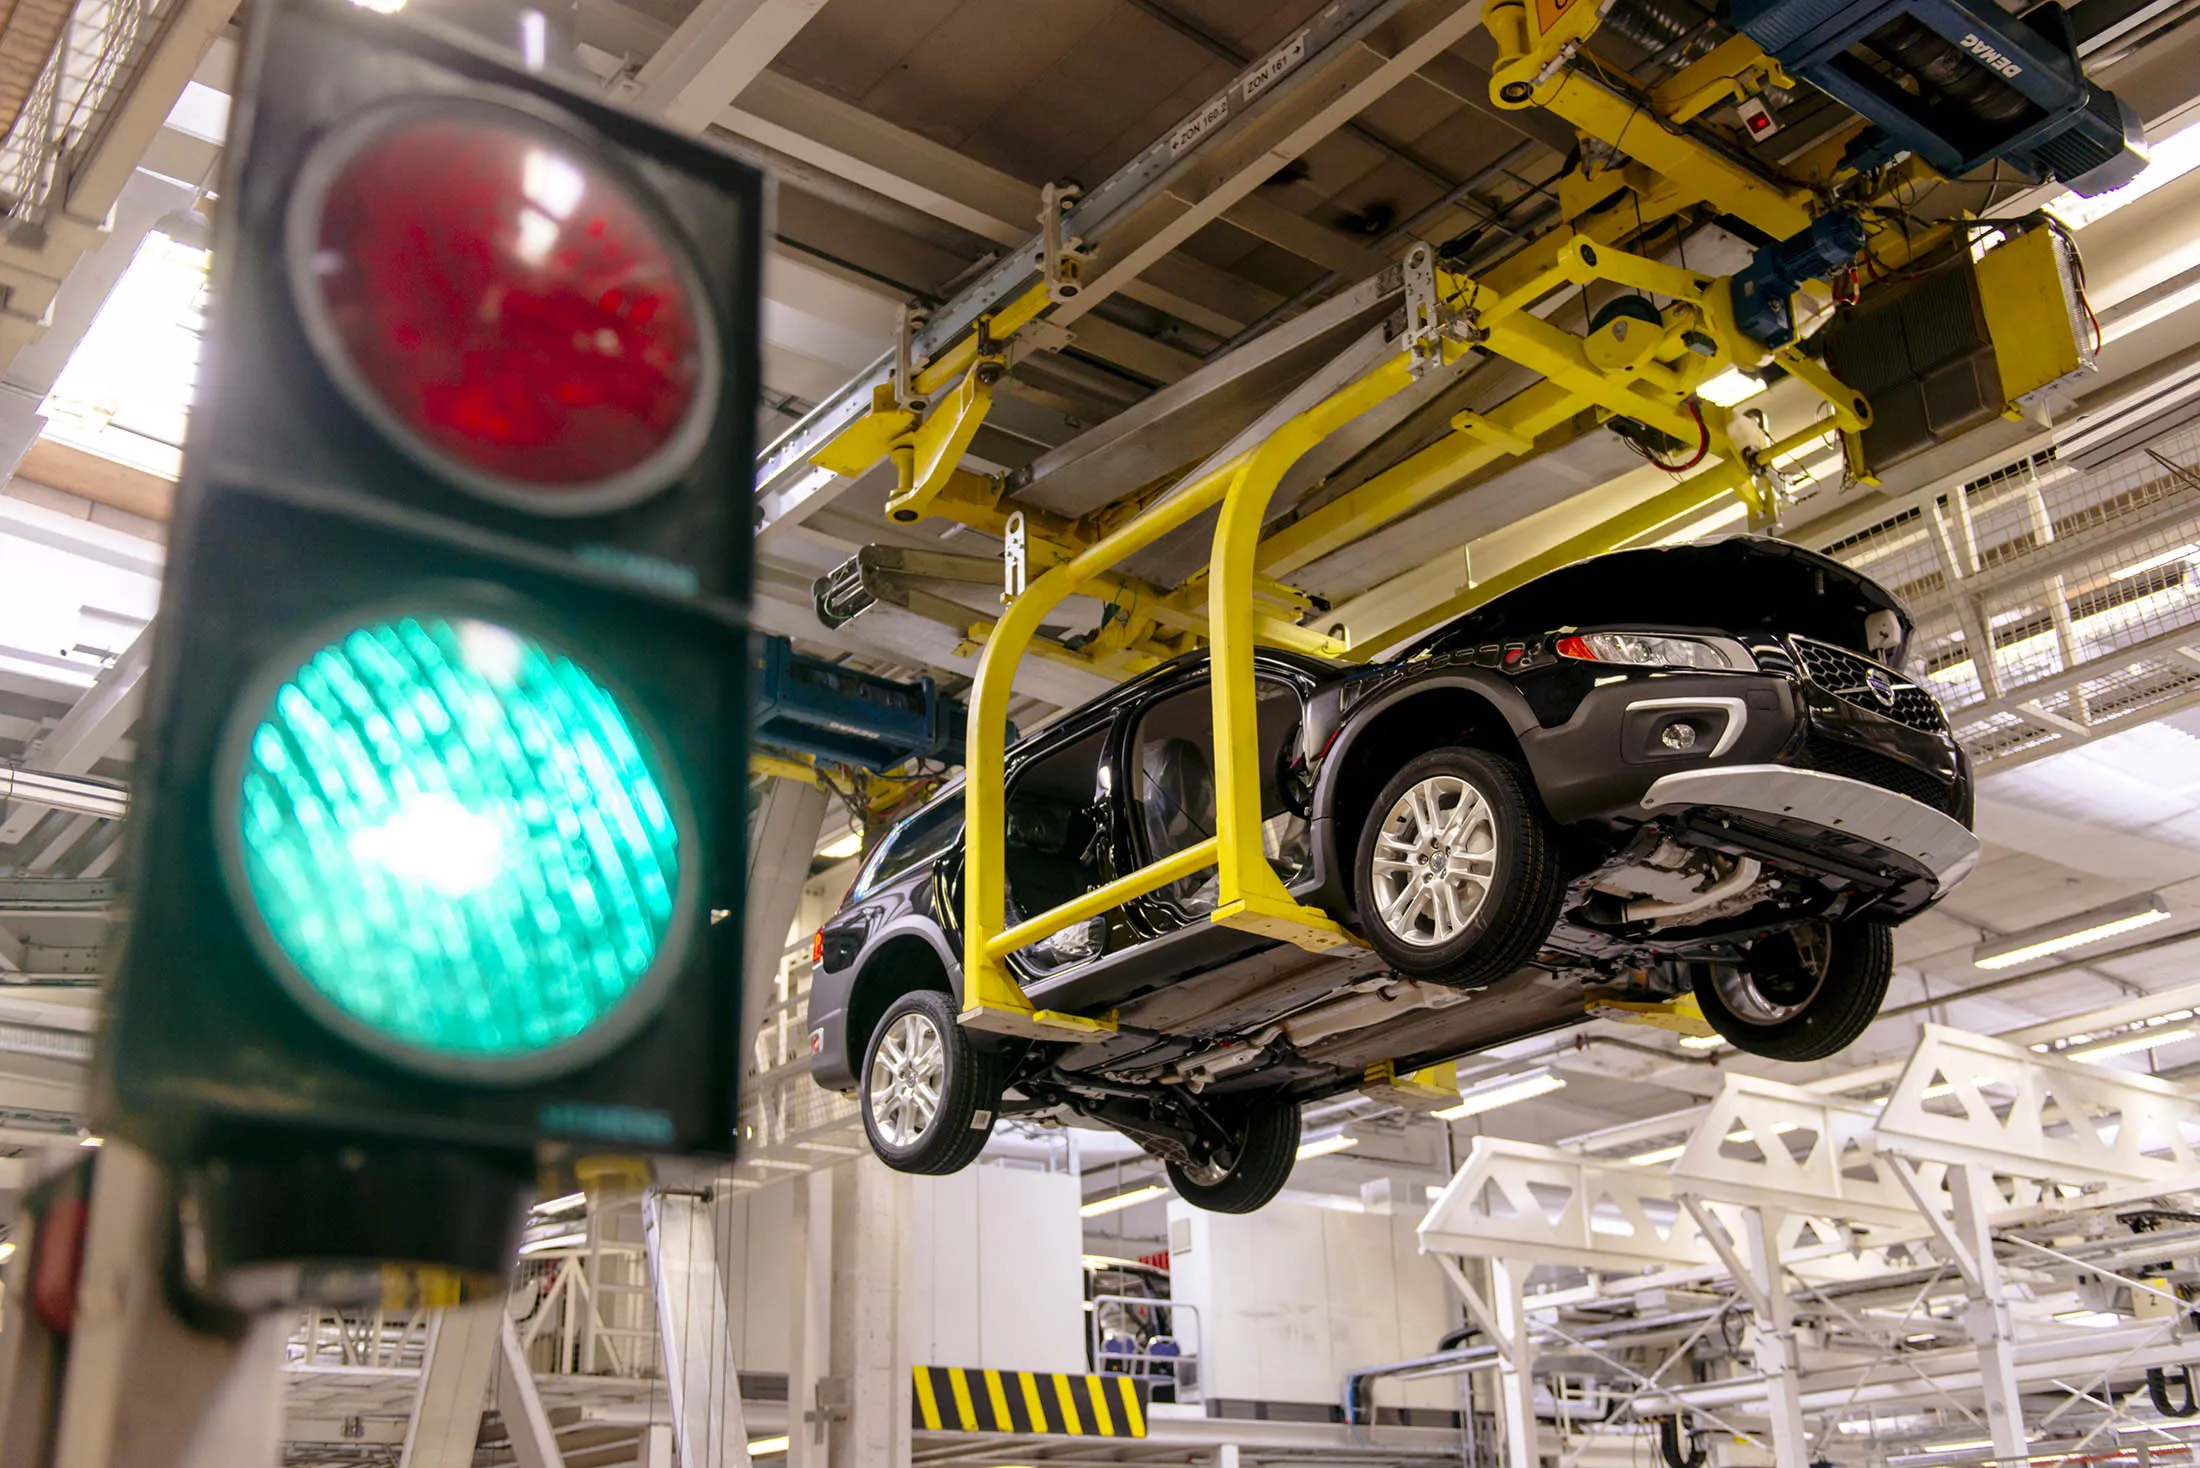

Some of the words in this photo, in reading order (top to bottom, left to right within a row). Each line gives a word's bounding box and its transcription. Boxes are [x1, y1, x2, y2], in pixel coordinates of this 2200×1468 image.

[1248, 69, 1268, 93] ZON
[1272, 55, 1287, 74] 161
[1181, 121, 1200, 145] ZON
